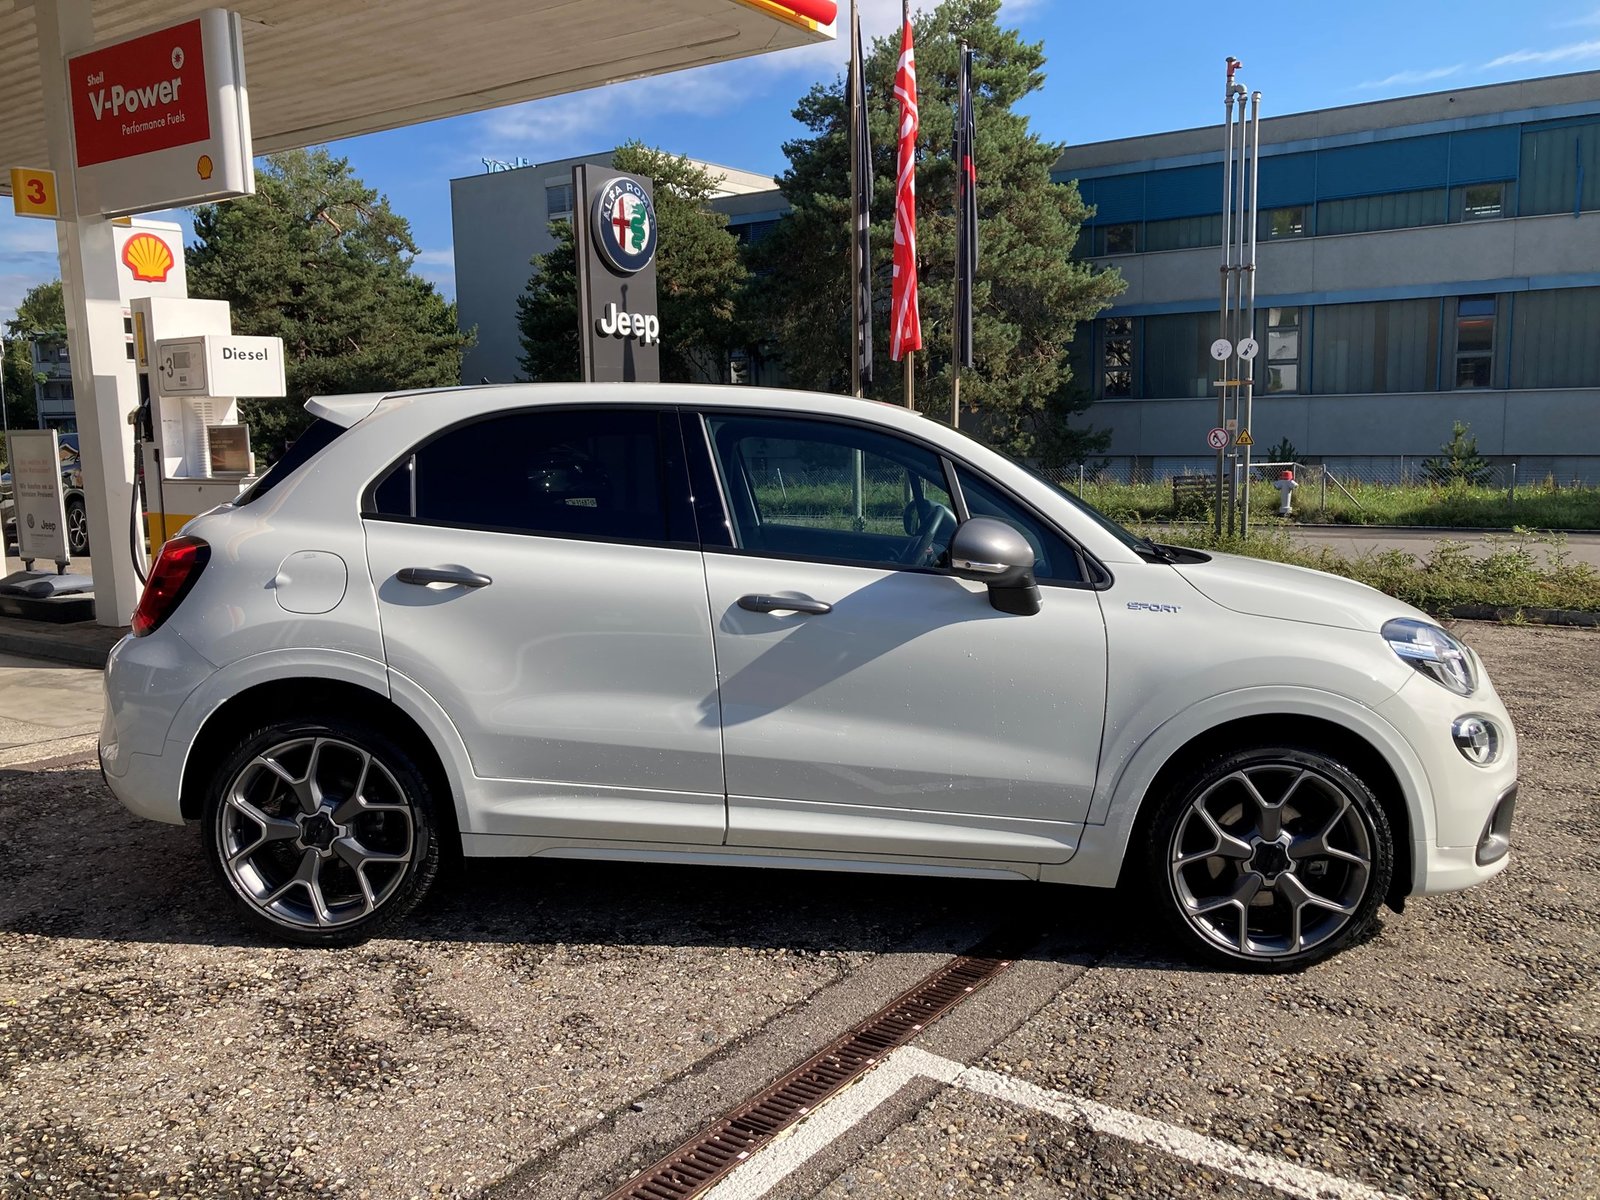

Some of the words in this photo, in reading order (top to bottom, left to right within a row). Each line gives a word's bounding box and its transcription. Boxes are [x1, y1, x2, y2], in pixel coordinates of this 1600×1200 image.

[87, 71, 104, 86] Shell
[88, 77, 182, 121] V-Power
[121, 117, 166, 136] Performance
[167, 110, 186, 125] Fuels
[27, 179, 47, 205] 3
[603, 185, 623, 222] ALFA
[626, 182, 656, 231] ROMEO
[600, 302, 660, 344] Jeep
[222, 347, 268, 361] Diesel
[165, 357, 174, 378] 3
[40, 519, 57, 532] Jeep
[1127, 602, 1182, 613] SPORT
